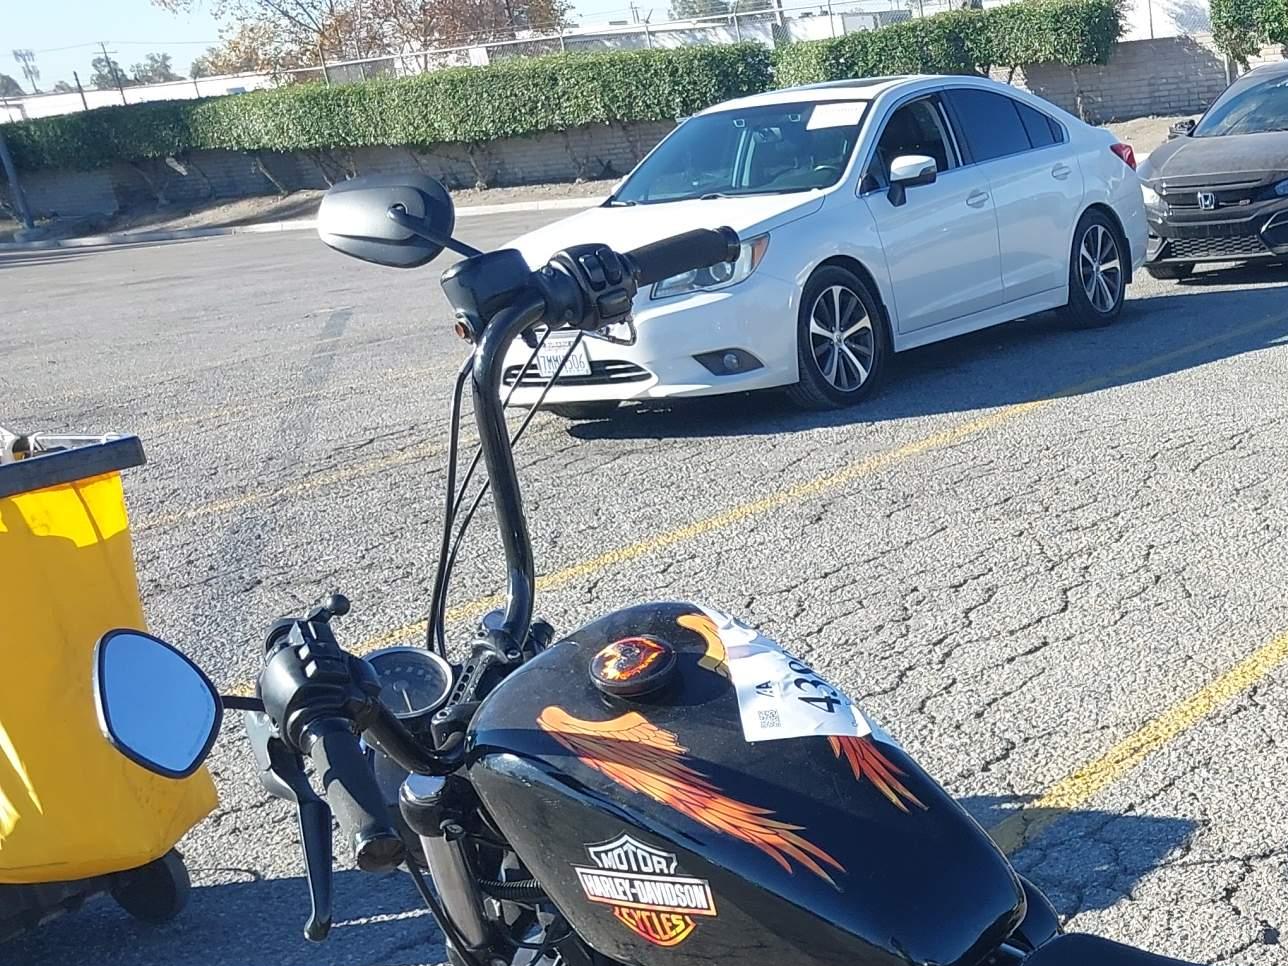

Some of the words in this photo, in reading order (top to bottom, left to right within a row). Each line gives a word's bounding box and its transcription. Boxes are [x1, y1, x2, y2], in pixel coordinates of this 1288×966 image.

[600, 843, 668, 874] MOTOR
[583, 874, 708, 909] HARLEY-DAVIDSON
[621, 907, 685, 940] CYCLES
